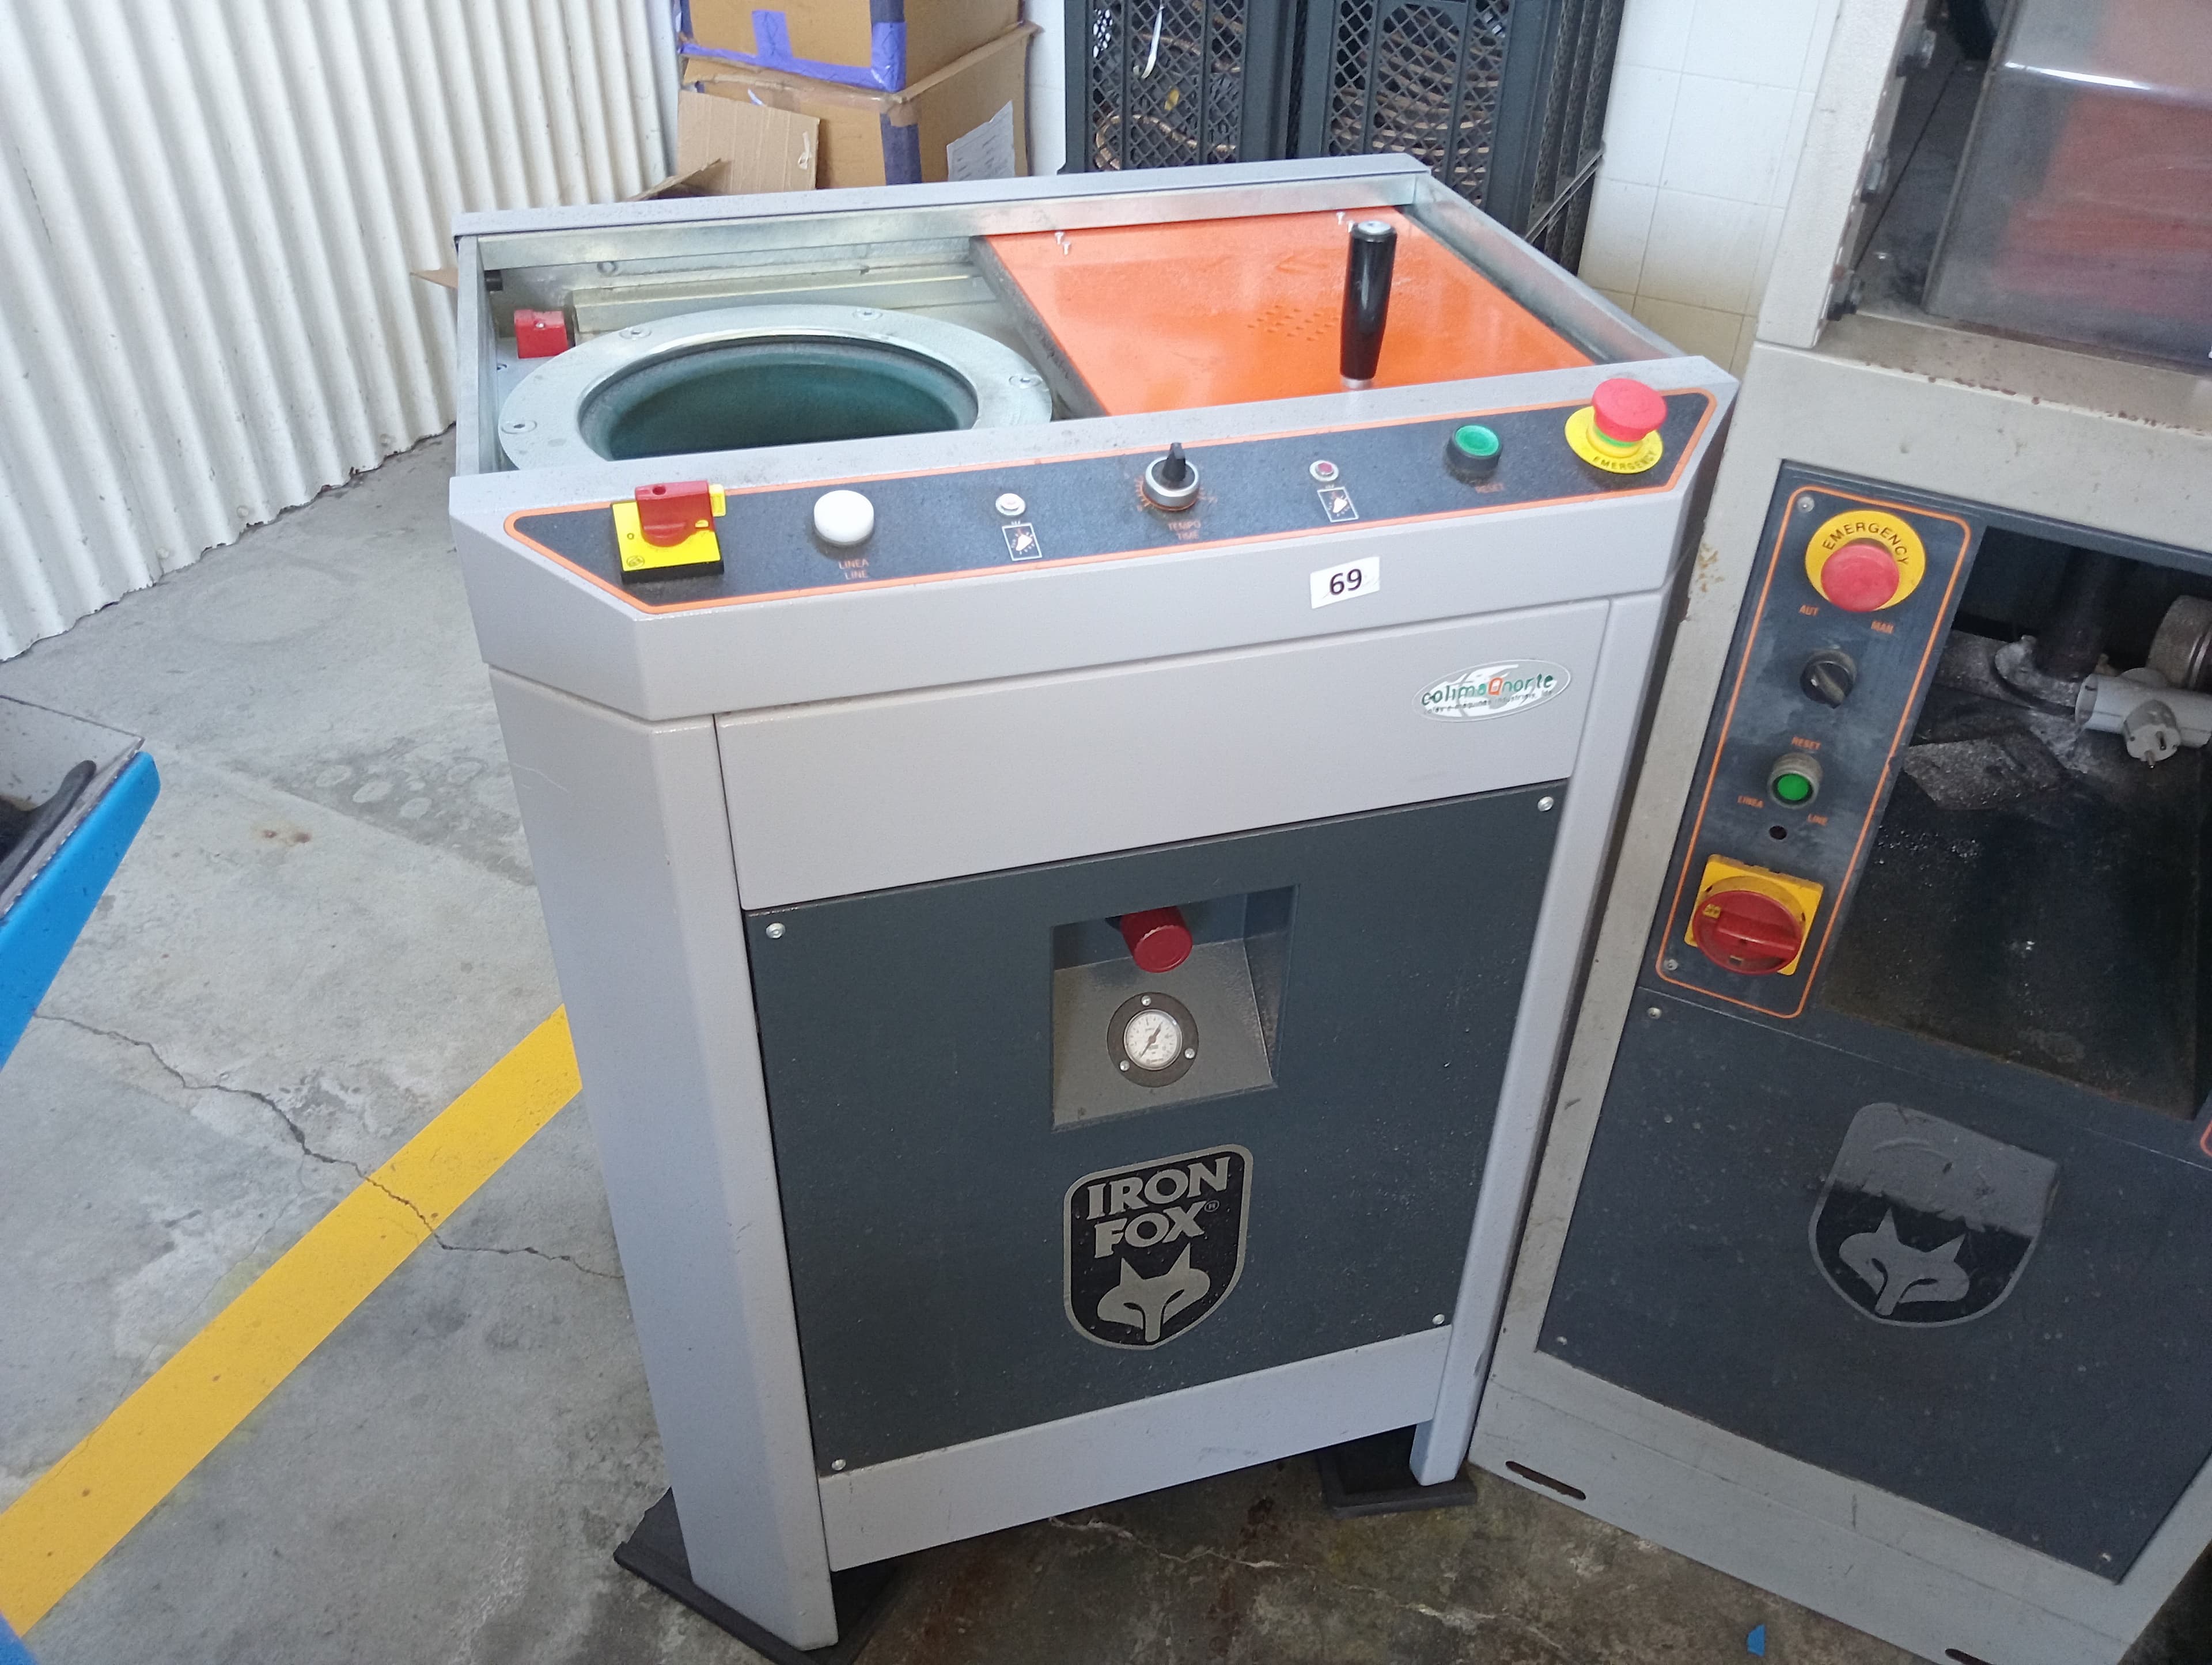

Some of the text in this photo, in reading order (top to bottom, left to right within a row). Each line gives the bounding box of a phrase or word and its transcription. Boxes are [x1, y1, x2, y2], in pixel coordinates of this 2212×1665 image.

[1592, 450, 1657, 470] EMERGENCY
[1168, 519, 1201, 530] TEMPO
[1177, 530, 1199, 540] TIME
[1822, 522, 1909, 565] EMERGENCY
[839, 559, 869, 569] LINEA
[844, 570, 868, 580] LINE
[1330, 568, 1362, 596] 69
[1798, 604, 1819, 617] AUT
[1870, 620, 1894, 634] MAN
[1791, 736, 1821, 750] RESET
[1737, 795, 1765, 809] LINEA
[1807, 813, 1829, 826] LINE
[1086, 1156, 1230, 1220] IRON
